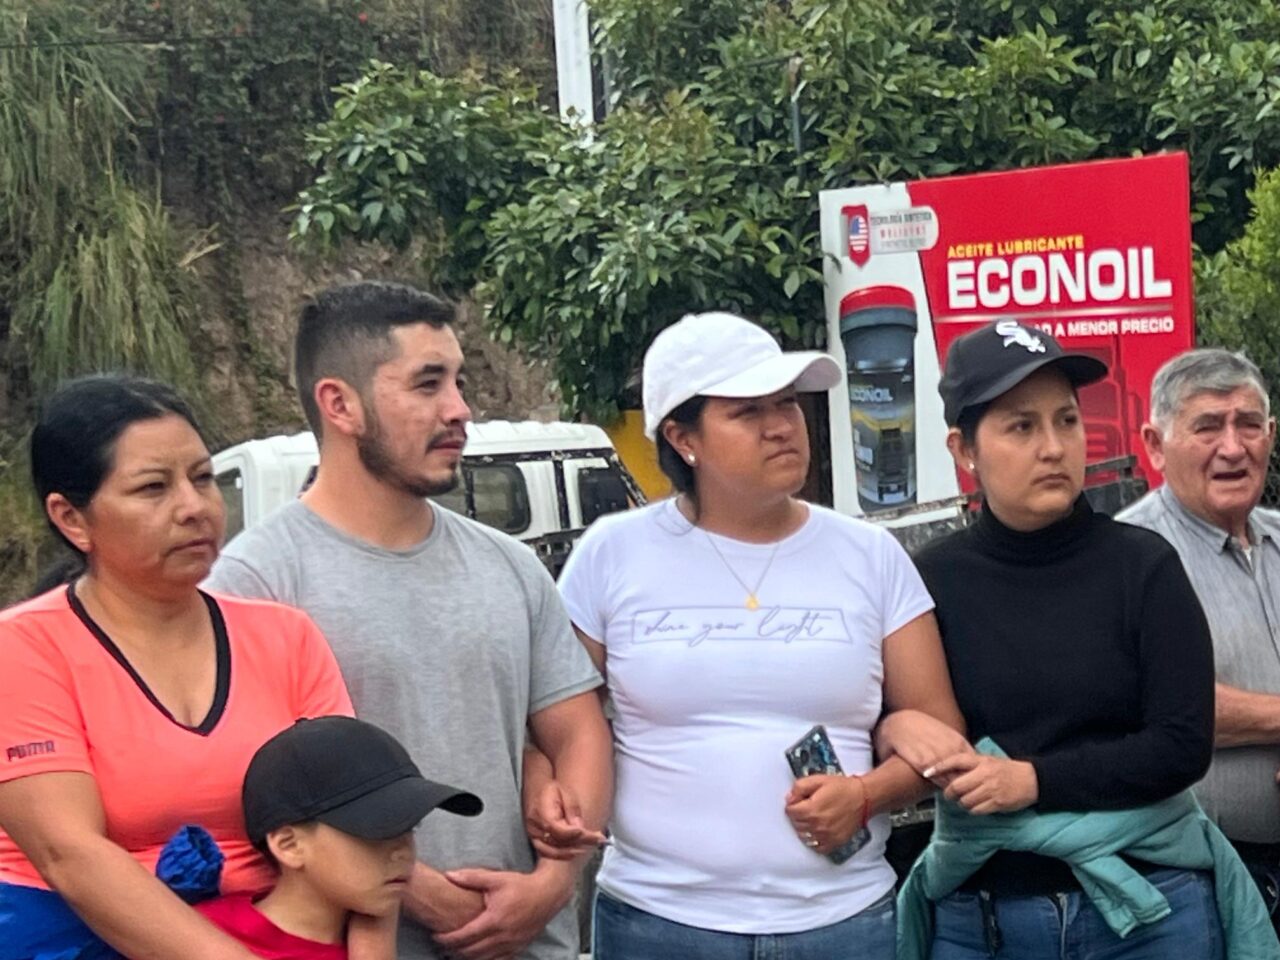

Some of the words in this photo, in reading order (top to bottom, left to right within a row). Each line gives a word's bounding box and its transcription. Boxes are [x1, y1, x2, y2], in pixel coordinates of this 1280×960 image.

[948, 242, 993, 258] ACEITE
[998, 235, 1084, 256] LUBRICANTE
[947, 246, 1173, 309] ECONOIL
[1055, 322, 1066, 337] A
[1068, 319, 1118, 337] MENOR
[1121, 316, 1174, 335] PRECIO
